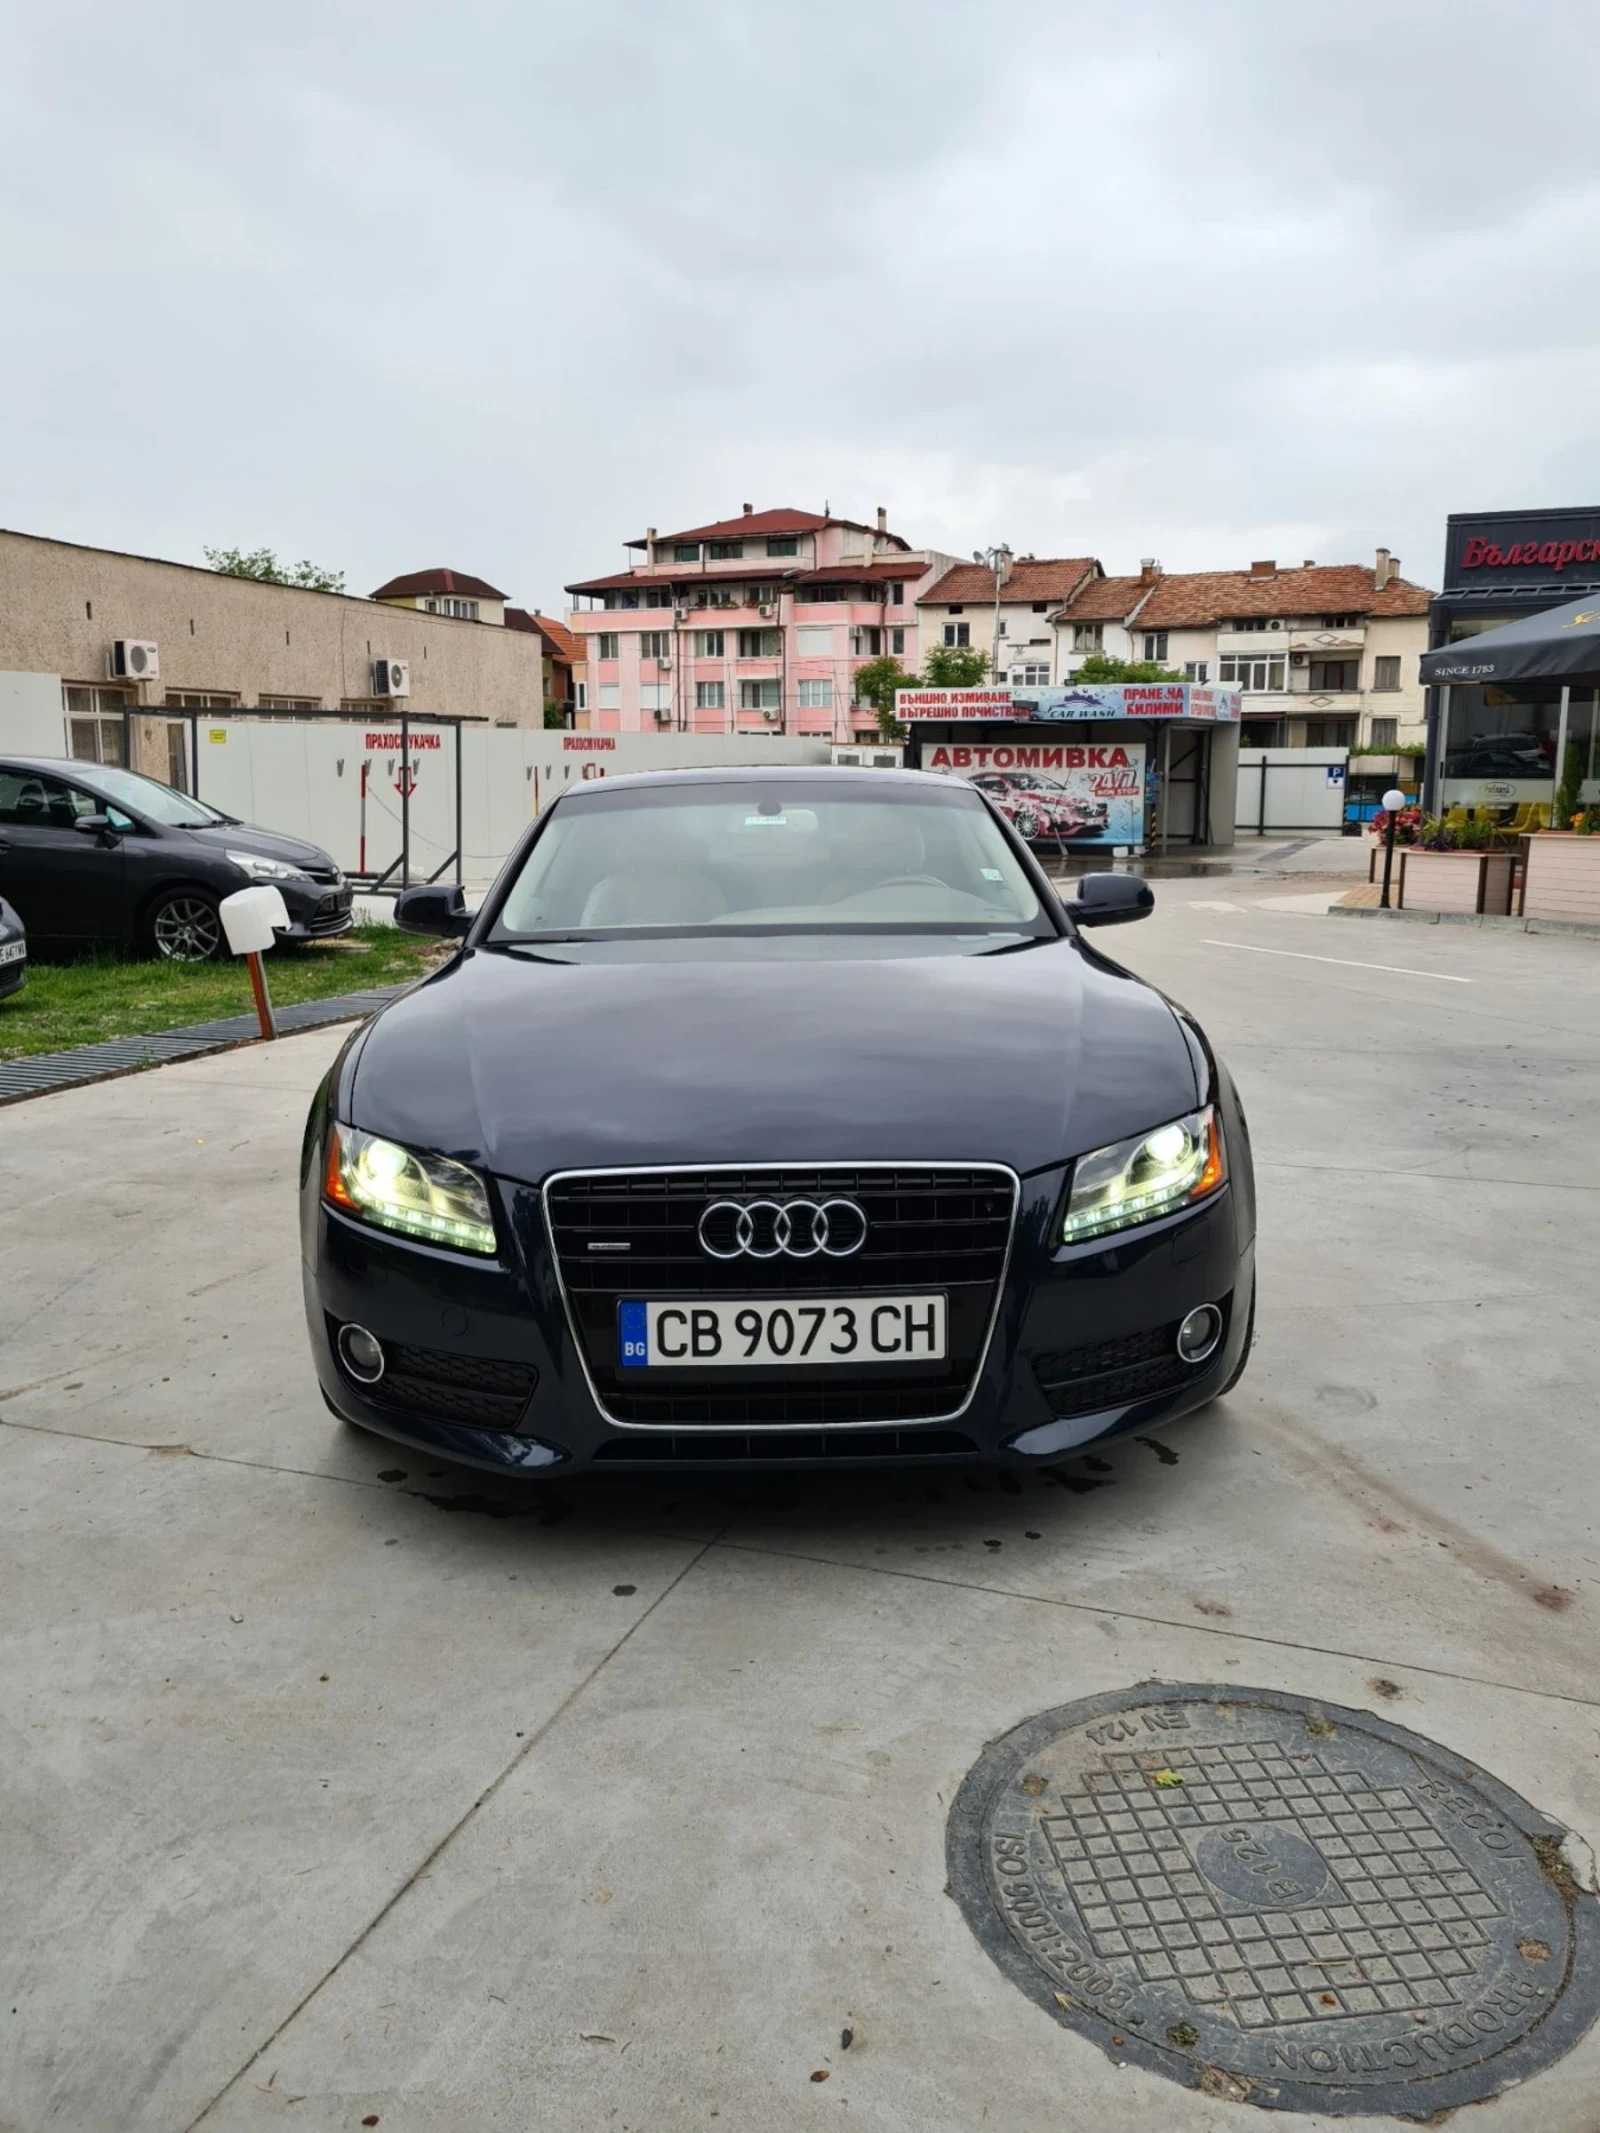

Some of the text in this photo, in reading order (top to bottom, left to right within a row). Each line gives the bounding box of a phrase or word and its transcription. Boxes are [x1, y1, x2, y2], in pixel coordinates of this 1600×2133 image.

[1435, 664, 1494, 676] SINCE 1783
[900, 691, 1012, 705] ВЪНШНО ИЗМИВАНЕ
[1123, 688, 1160, 700] ПРАНЕ
[900, 706, 958, 719] ВЪТРЕШНО
[1050, 709, 1115, 718] CAR WASH
[1126, 702, 1184, 715] КИЛИМИ
[365, 733, 441, 750] ПРАХОСУКАЧКА
[563, 737, 616, 751] ПРАХОСМУКАЧКА
[930, 747, 1130, 769] АВТОМИВКА
[1333, 767, 1342, 777] P
[1089, 770, 1137, 792] 24/7
[1117, 787, 1138, 795] STOP
[657, 1303, 936, 1358] CB 9073 CH
[624, 1342, 645, 1357] BG
[1141, 1710, 1191, 1732] EN
[1220, 1827, 1305, 1899] B 125
[994, 1832, 1134, 2010] ISO 9001:2008
[1264, 1974, 1538, 2074] PRODUCTION
